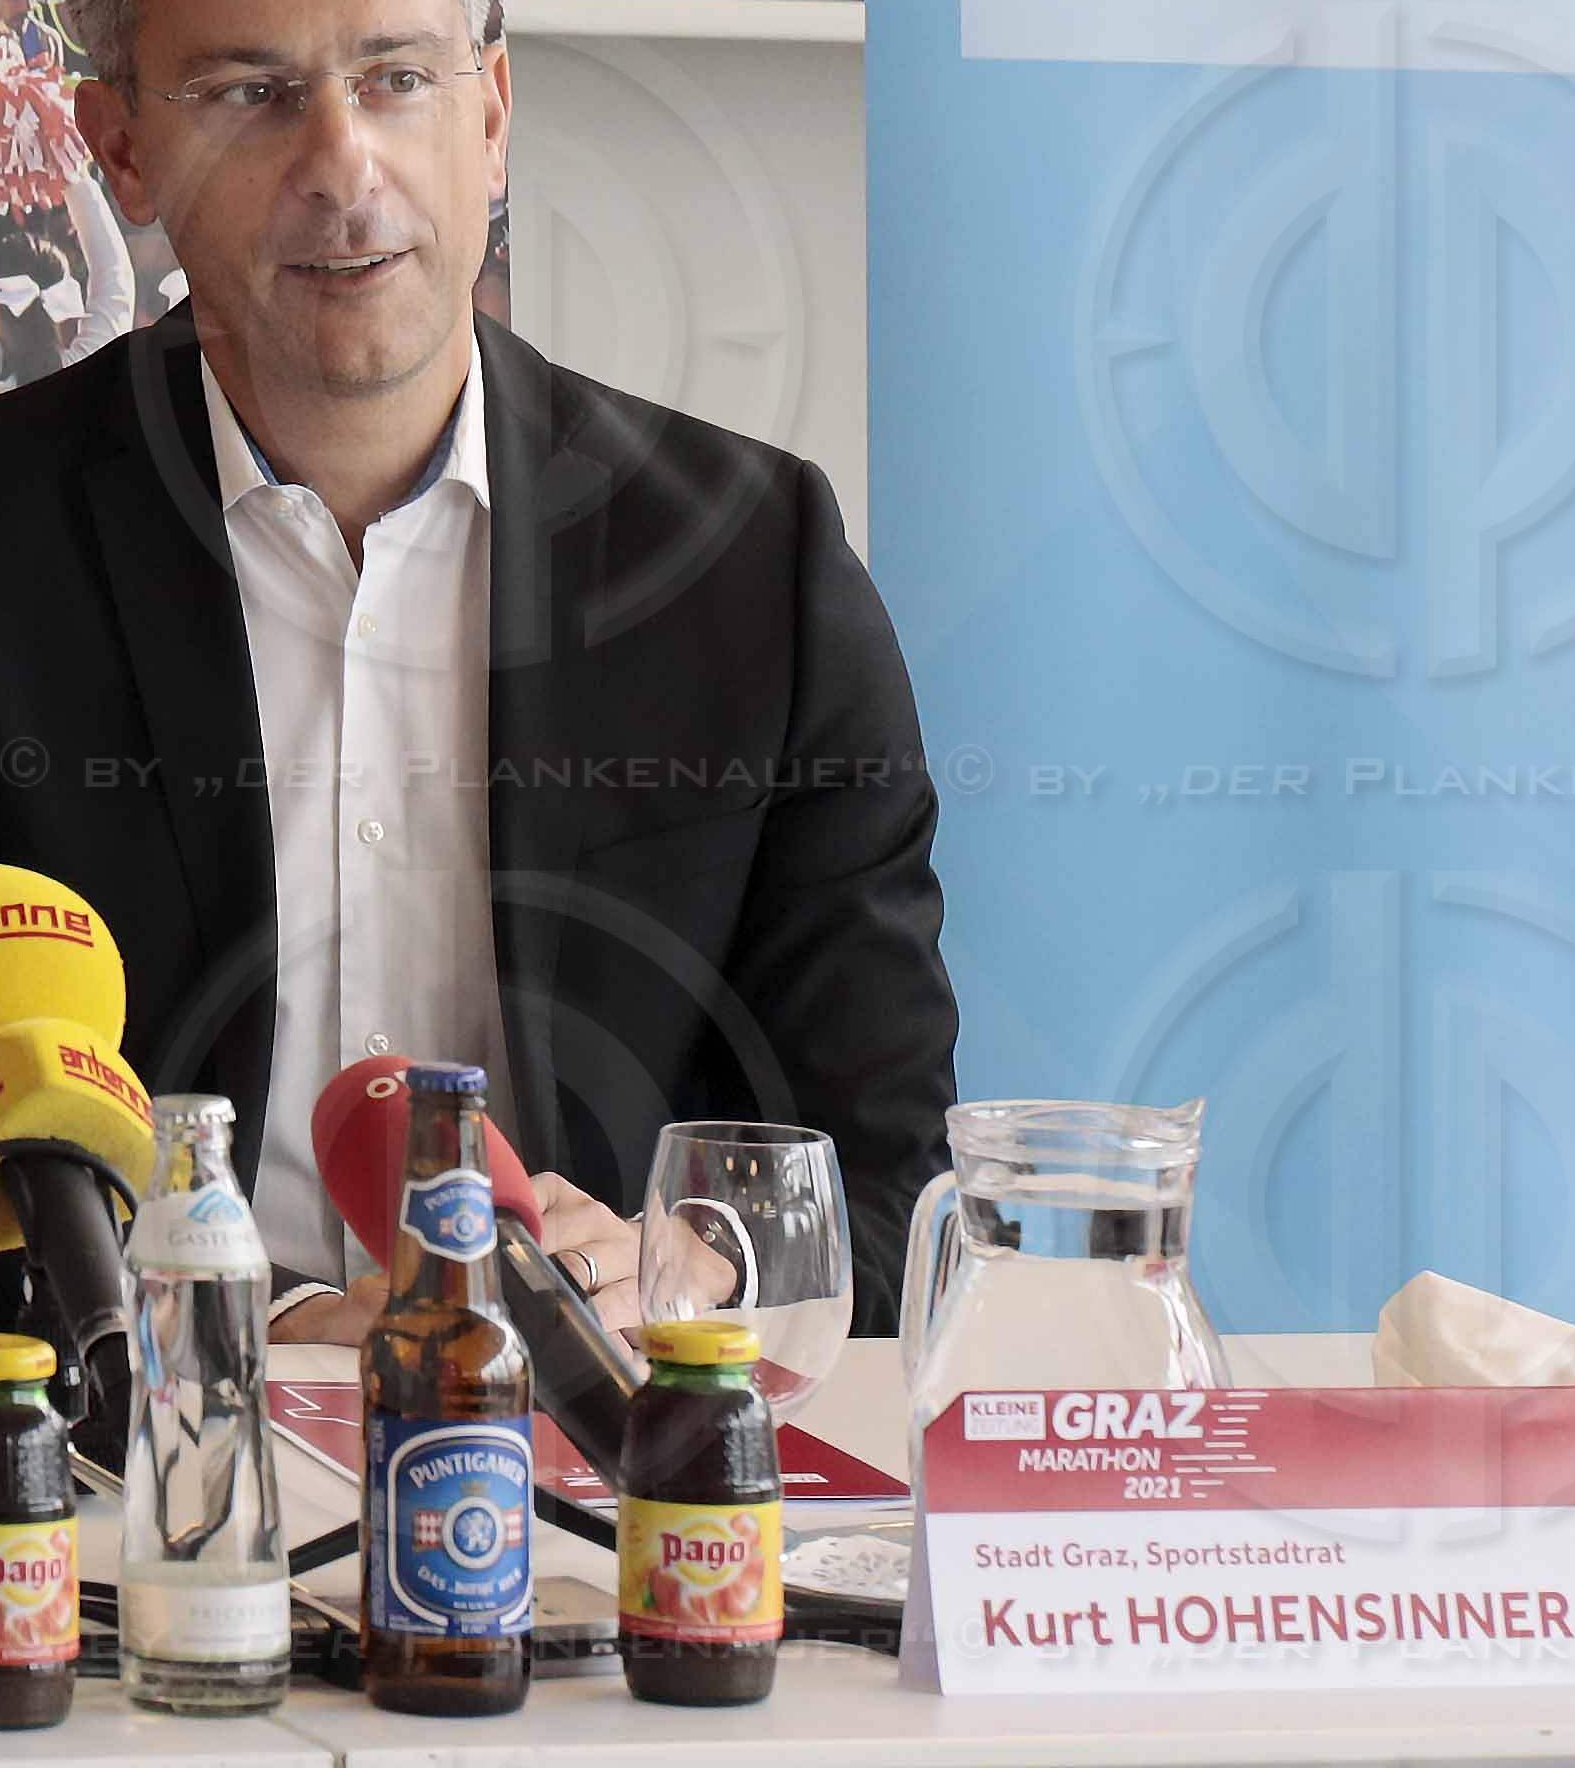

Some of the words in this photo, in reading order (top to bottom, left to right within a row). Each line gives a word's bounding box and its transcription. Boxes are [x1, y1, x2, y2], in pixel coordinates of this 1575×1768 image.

[969, 1400, 1040, 1417] KLEINE
[1052, 1392, 1207, 1441] GRAZ
[1018, 1447, 1162, 1473] MARATHON
[1122, 1475, 1182, 1500] 2021
[662, 1533, 746, 1573] pago
[974, 1541, 1055, 1570] Stadt
[1062, 1541, 1140, 1573] Graz,
[1145, 1538, 1348, 1572] Sportstadtrat
[980, 1594, 1125, 1650] Kurt
[1130, 1590, 1575, 1646] HOHENSINNER
